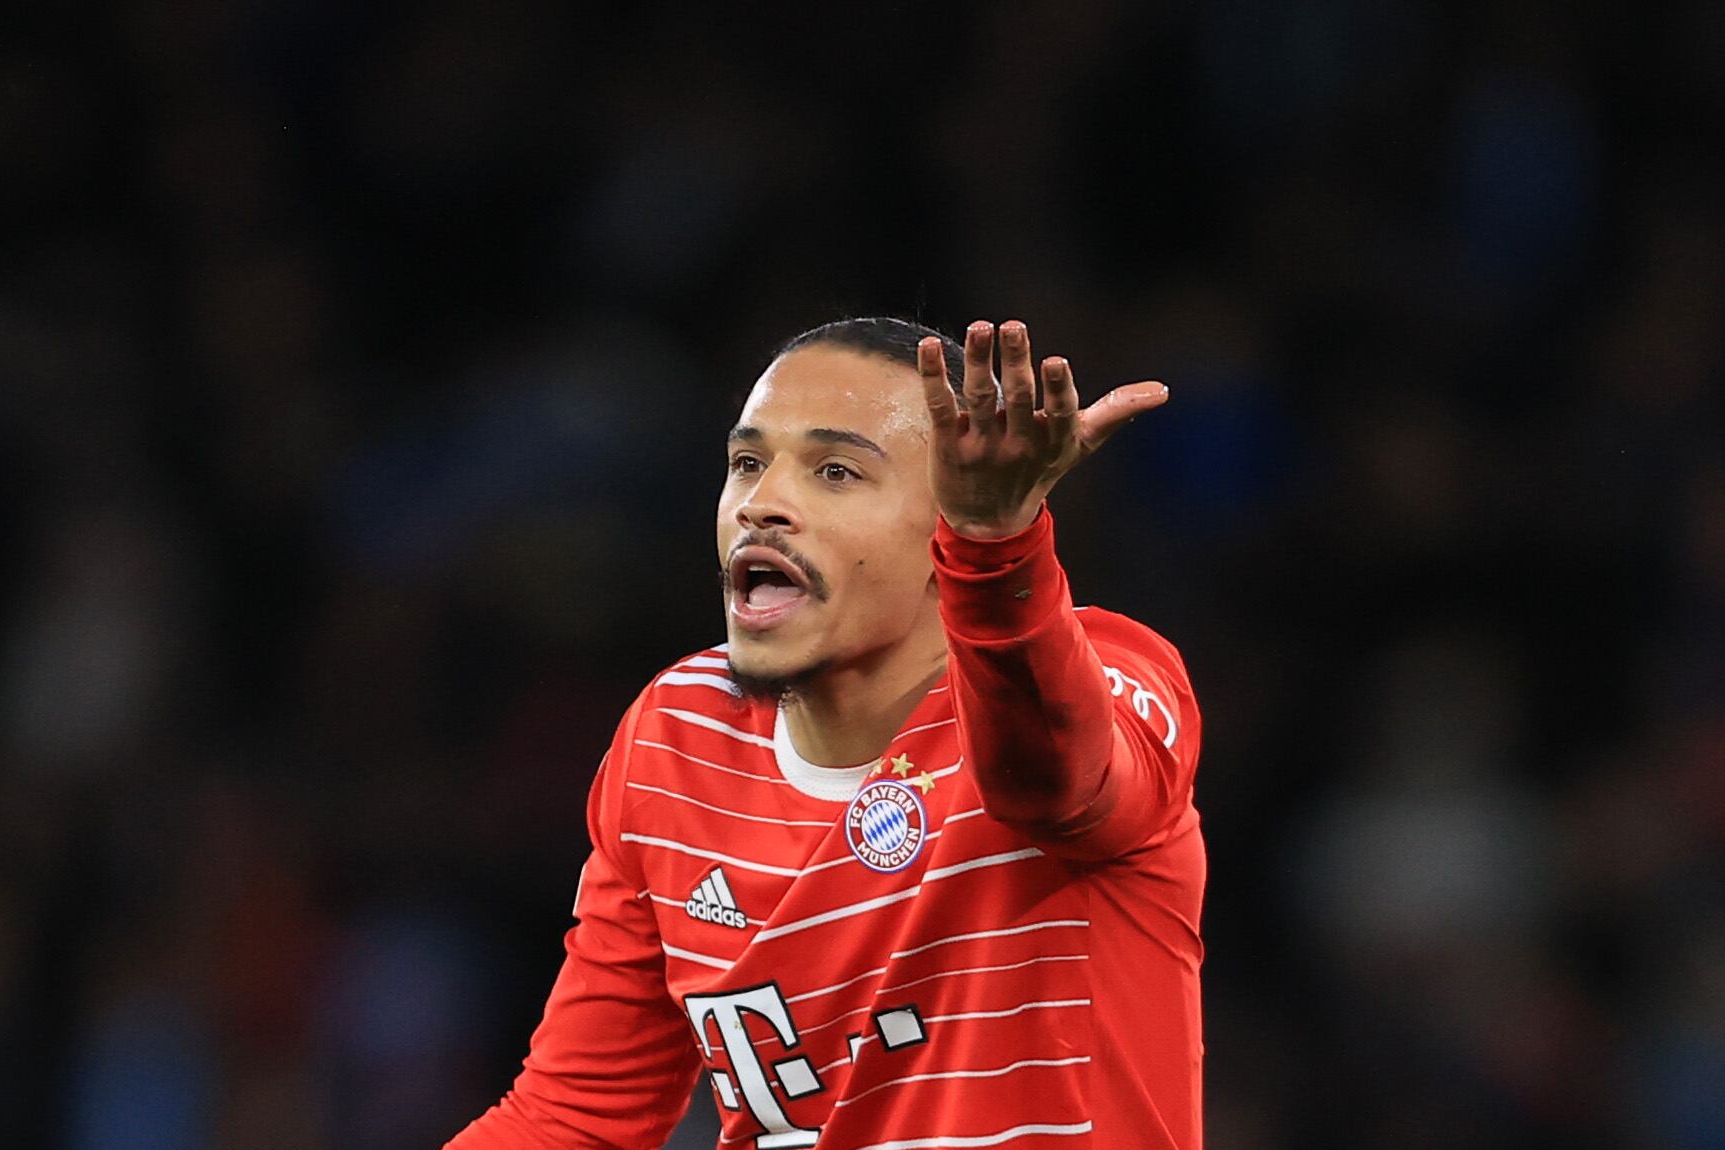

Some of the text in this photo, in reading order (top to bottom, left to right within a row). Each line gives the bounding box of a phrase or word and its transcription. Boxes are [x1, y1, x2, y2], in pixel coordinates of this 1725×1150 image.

[850, 785, 916, 829] FC BAYERN
[686, 899, 747, 929] adidas
